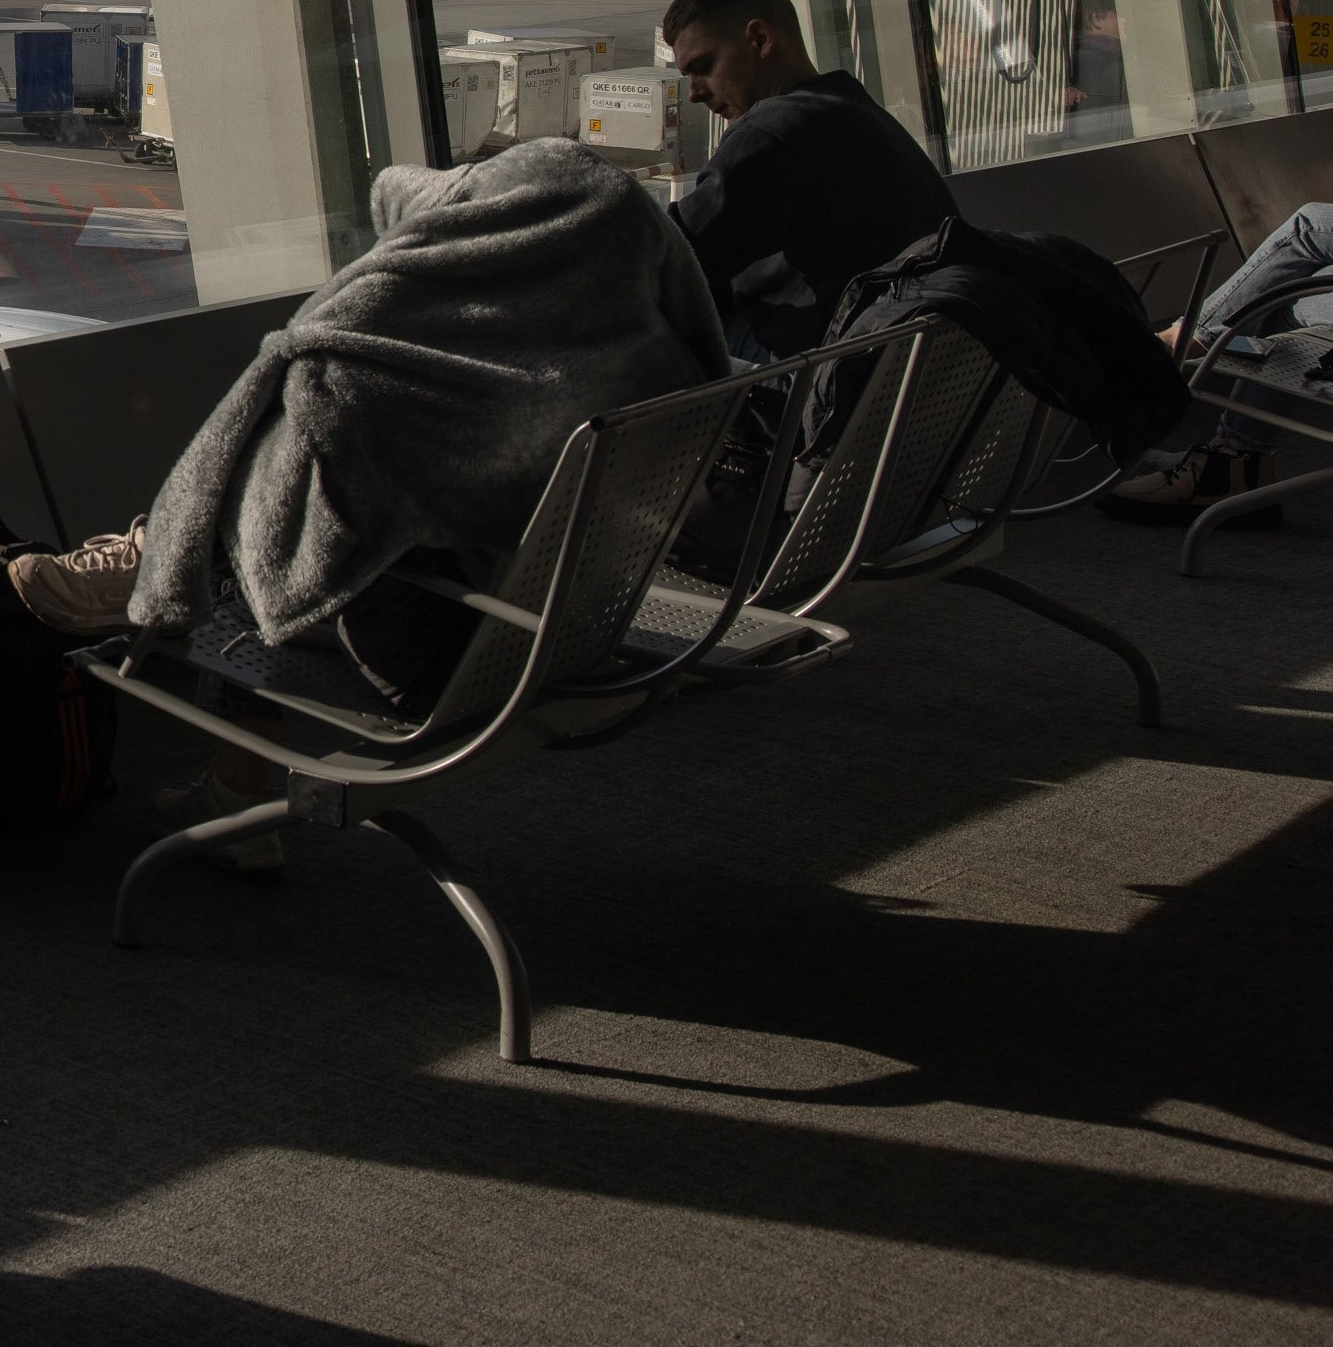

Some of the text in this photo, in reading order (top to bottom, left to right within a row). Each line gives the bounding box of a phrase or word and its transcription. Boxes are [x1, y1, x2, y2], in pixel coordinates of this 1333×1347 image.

[1310, 21, 1330, 38] 25
[592, 83, 610, 92] QKE
[637, 85, 650, 94] QR
[627, 102, 651, 110] CARGO
